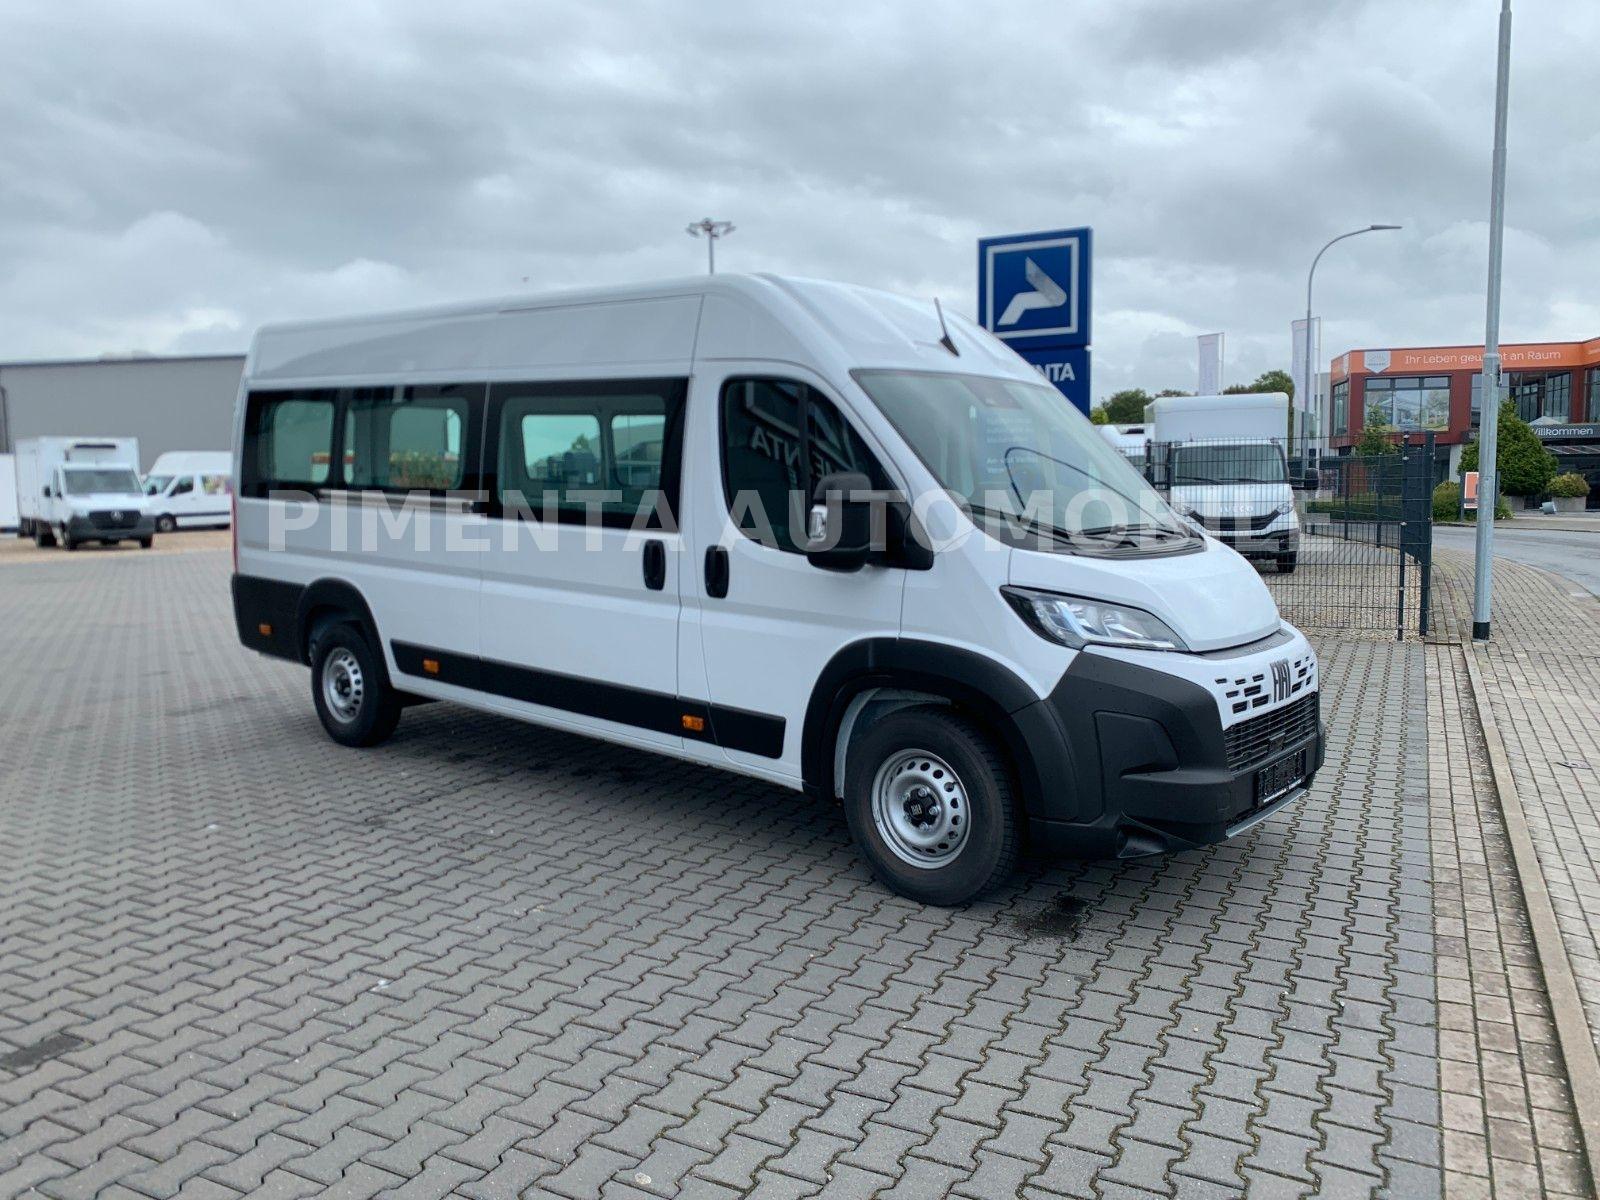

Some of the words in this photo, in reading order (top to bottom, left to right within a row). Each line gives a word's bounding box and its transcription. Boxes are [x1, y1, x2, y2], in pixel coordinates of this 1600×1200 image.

[1405, 355, 1421, 364] Ihr
[1423, 354, 1457, 364] Leben
[1460, 352, 1508, 365] gewt
[1510, 352, 1525, 361] an
[1527, 350, 1561, 361] Raum
[1032, 362, 1076, 382] NTA
